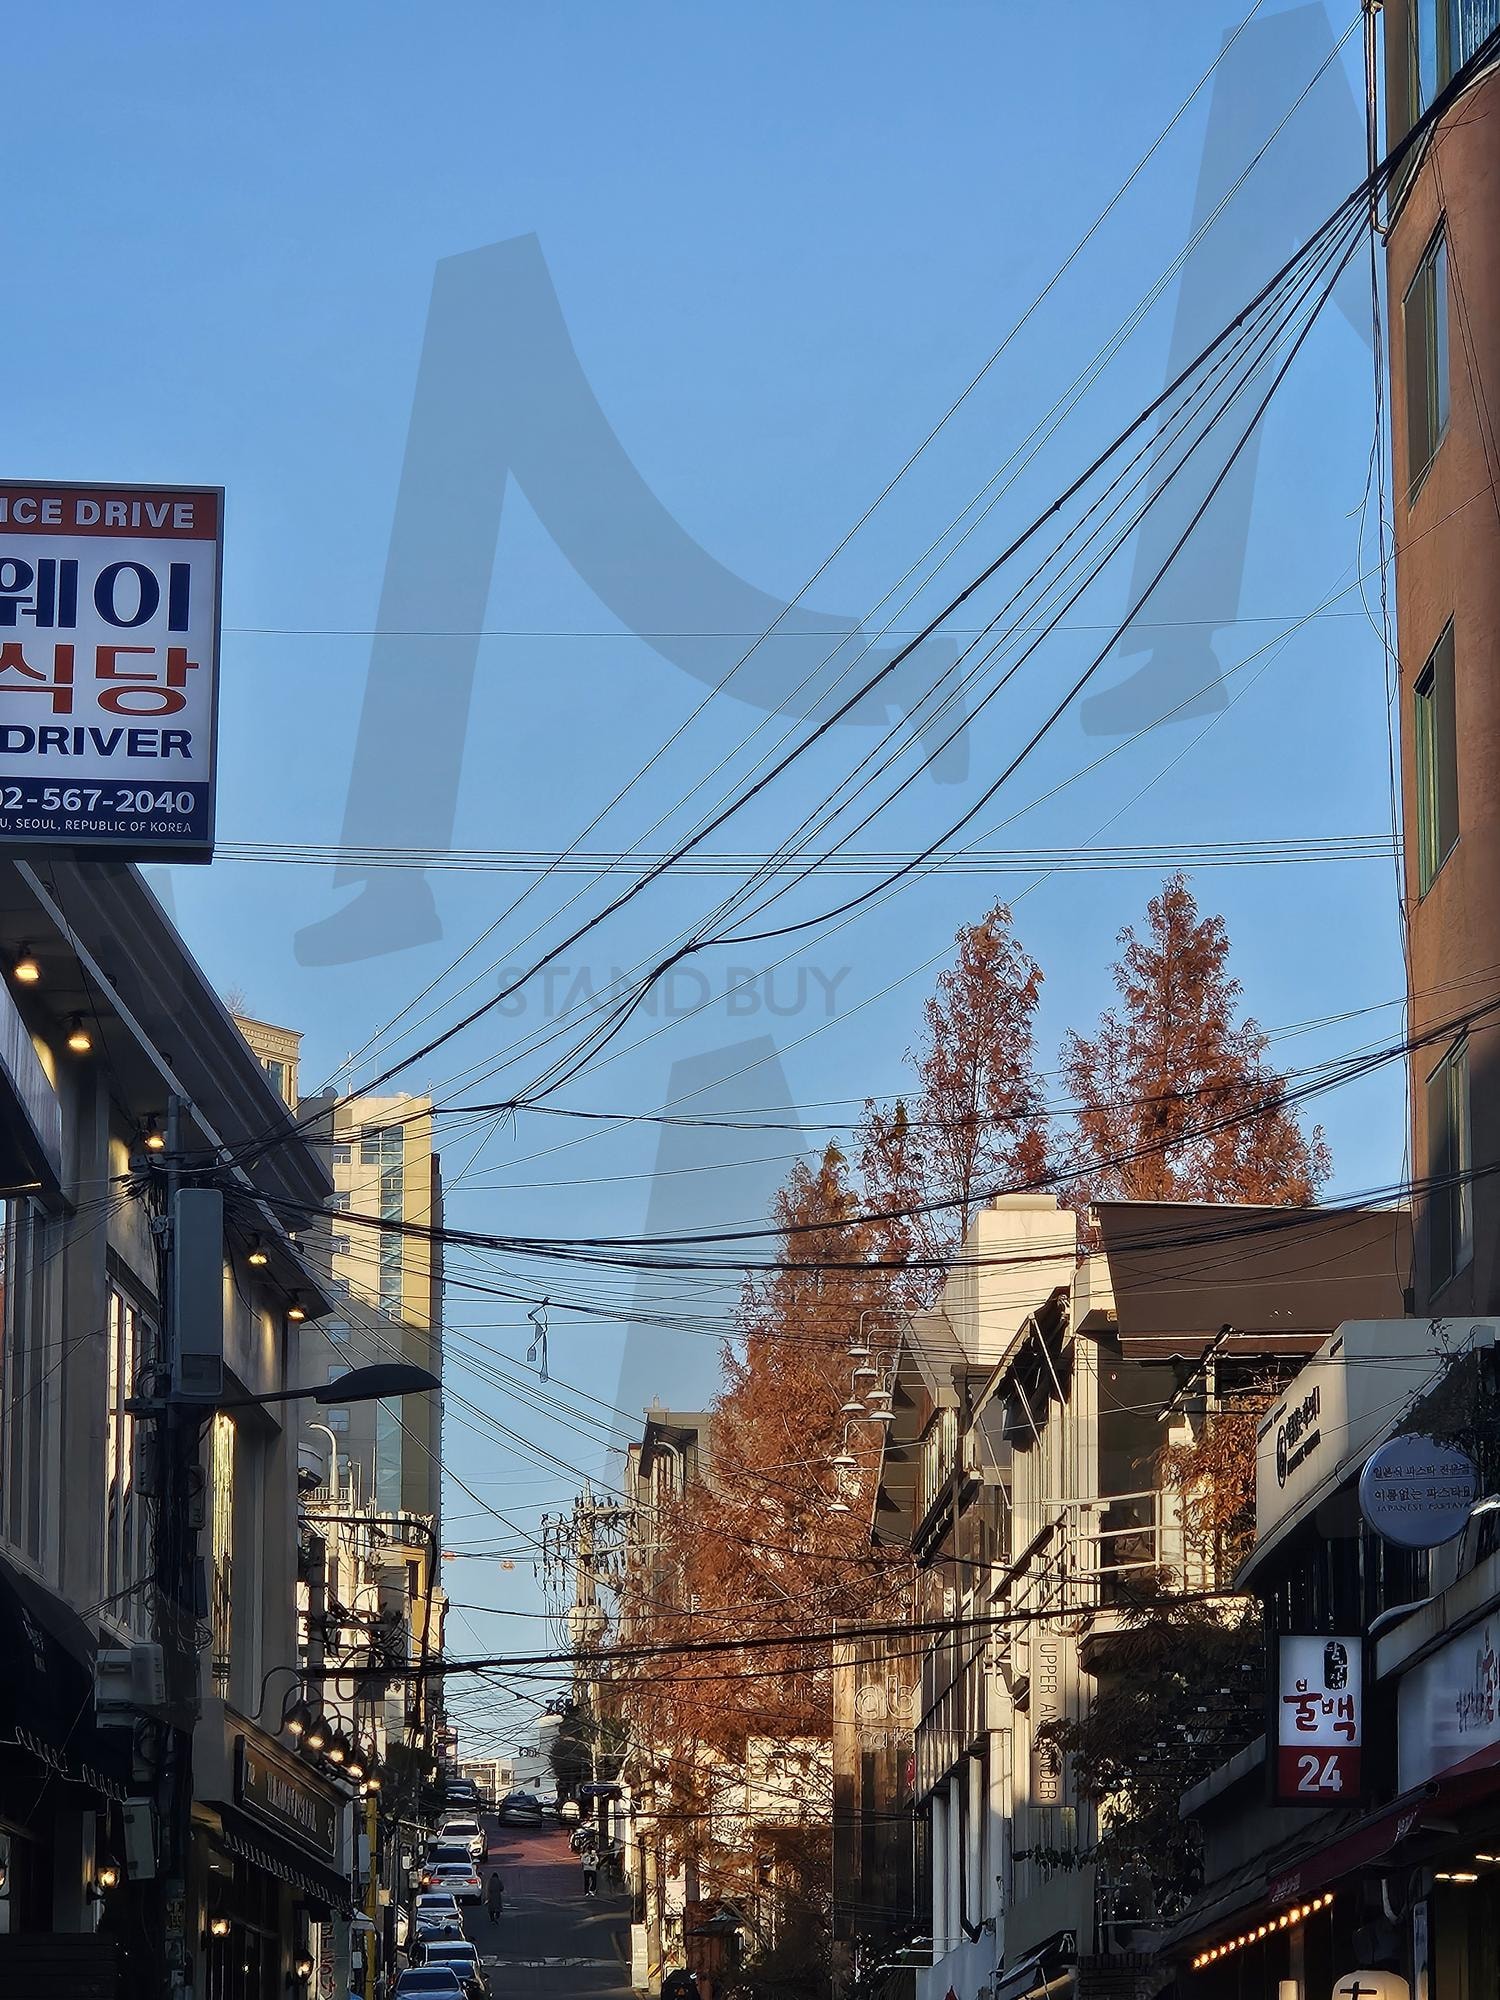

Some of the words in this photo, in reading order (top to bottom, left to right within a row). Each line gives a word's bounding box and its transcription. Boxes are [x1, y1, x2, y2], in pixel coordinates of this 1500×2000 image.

[76, 500, 194, 529] DRIVE
[0, 557, 191, 632] 웨이
[0, 642, 200, 717] 식당
[0, 725, 193, 759] DRIVER
[0, 787, 195, 814] 2-567-2040
[16, 818, 61, 831] SEOUL,
[65, 819, 127, 832] REPUBLIC
[130, 821, 147, 832] OF
[150, 822, 192, 833] KOREA
[1374, 1487, 1422, 1501] 이름없는
[1040, 1643, 1057, 1694] UPPER
[1283, 1678, 1356, 1742] 불백
[1297, 1755, 1343, 1792] 24
